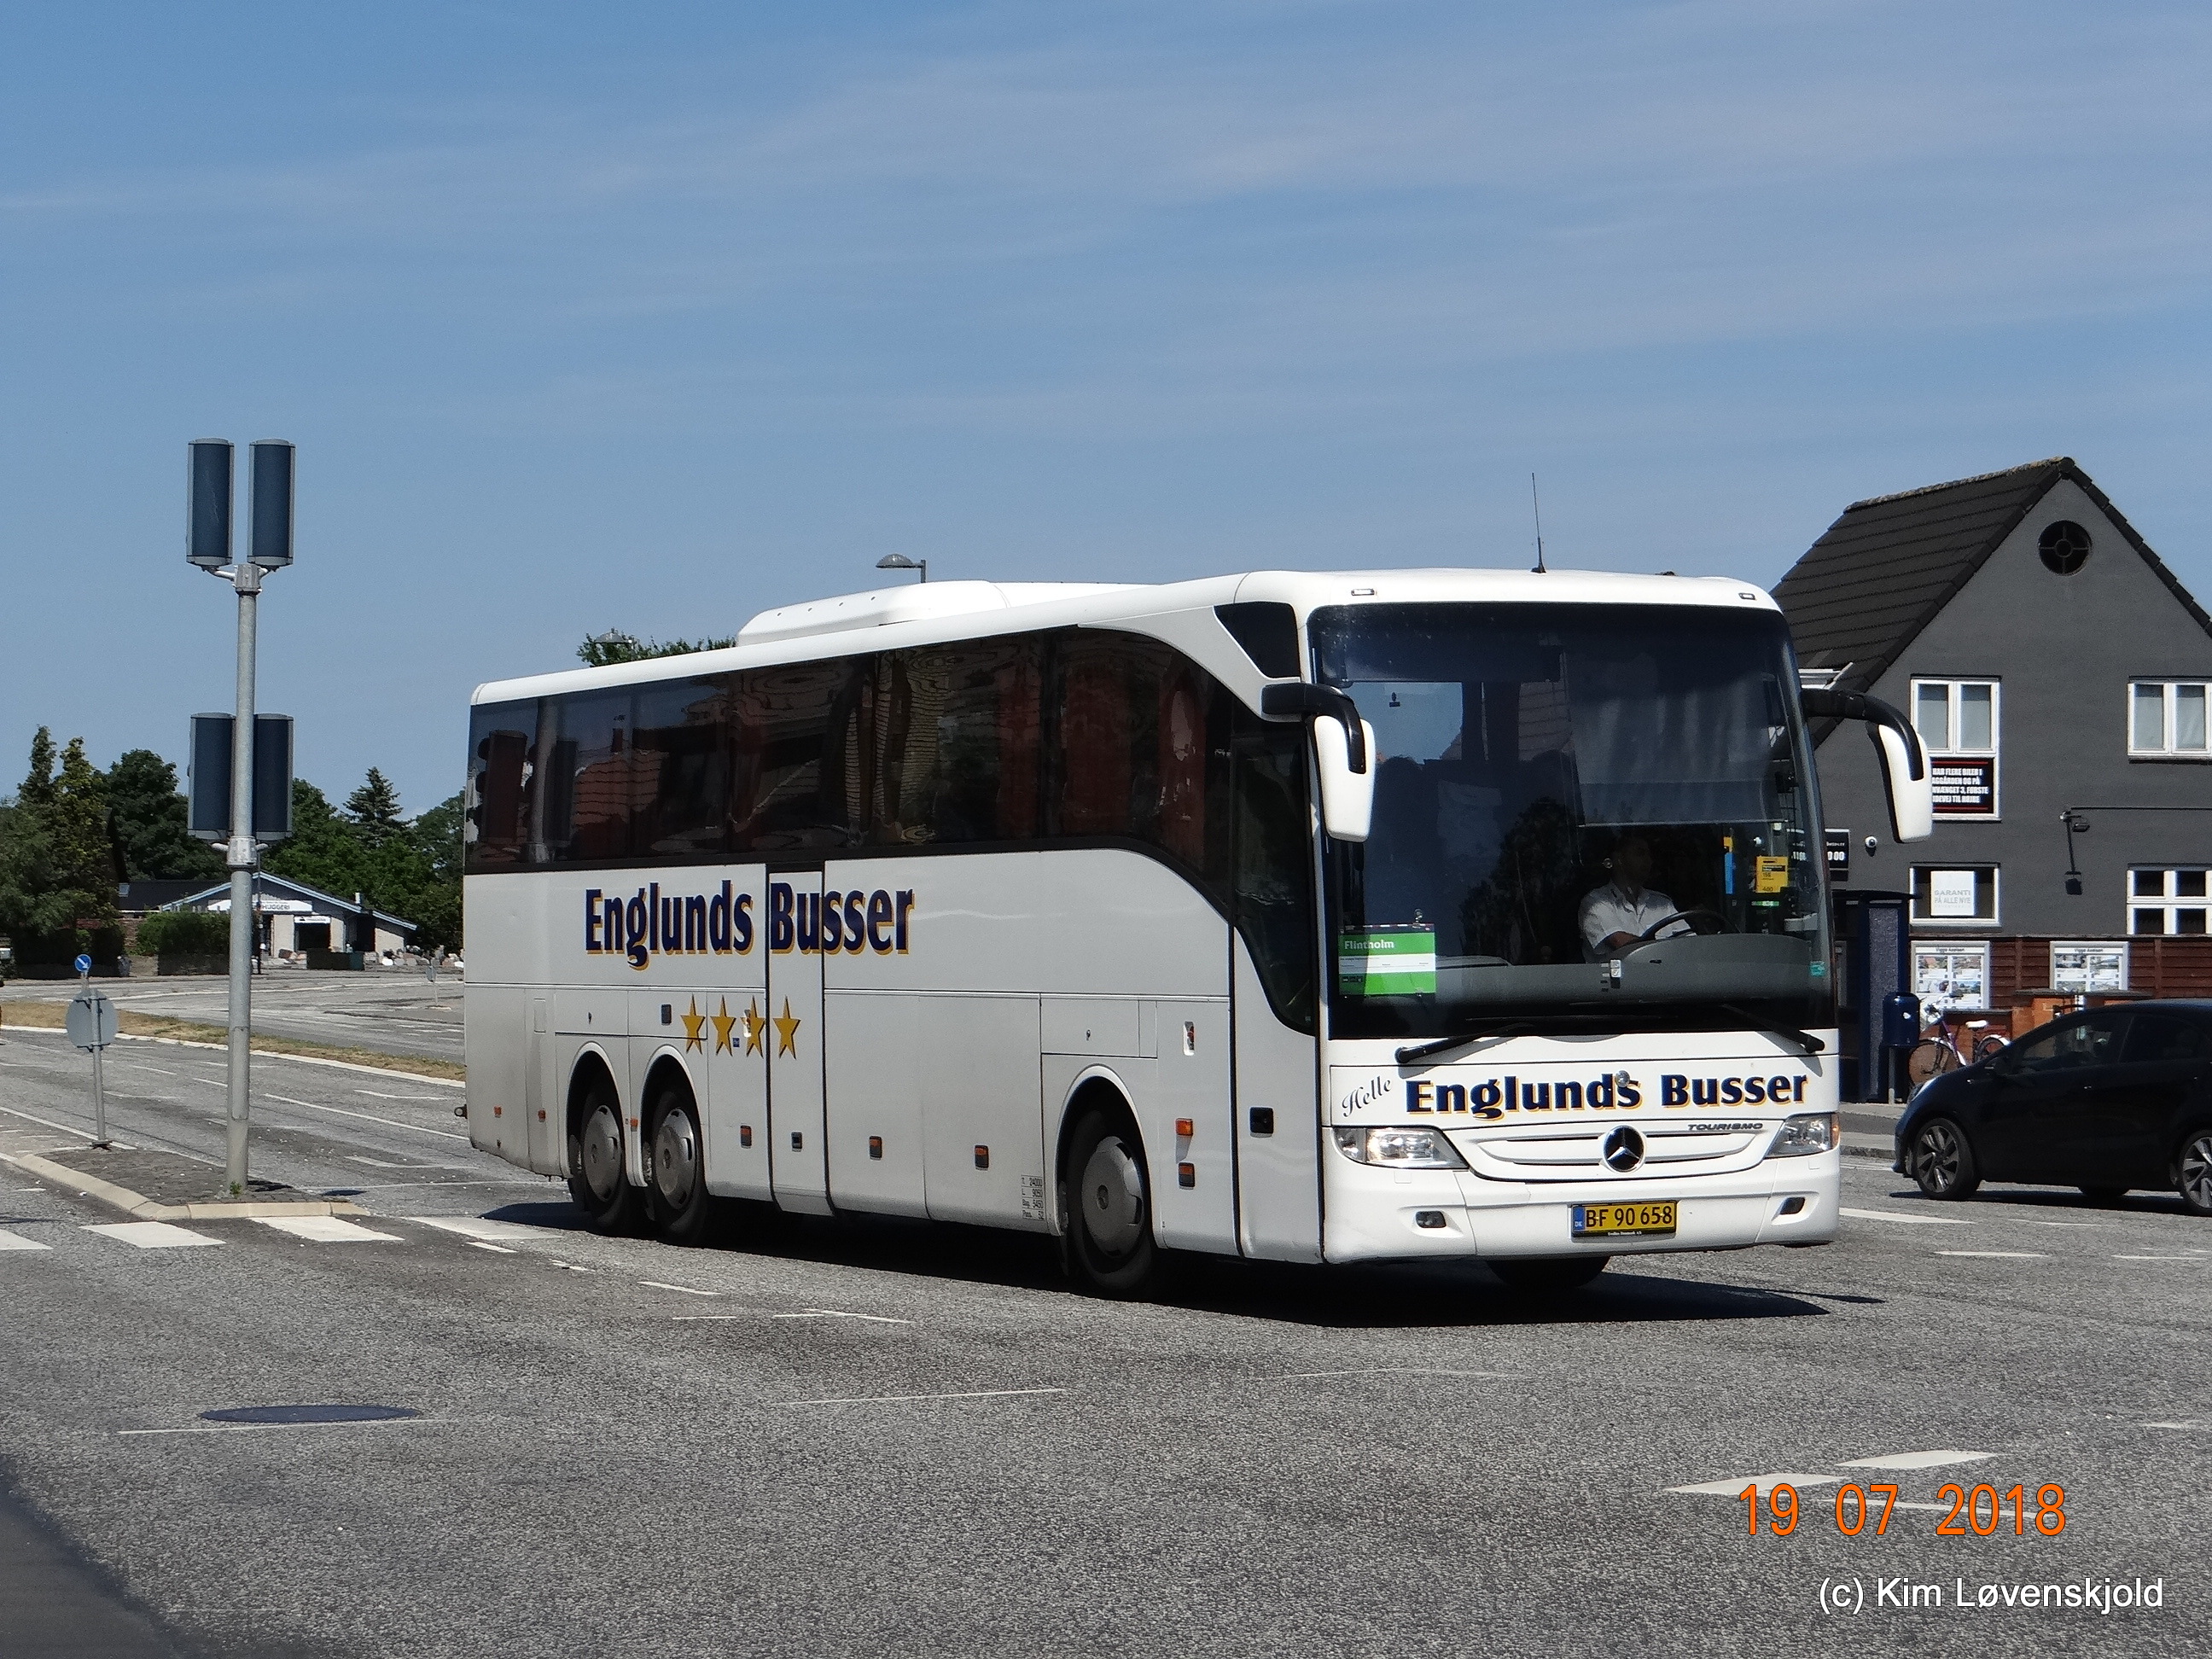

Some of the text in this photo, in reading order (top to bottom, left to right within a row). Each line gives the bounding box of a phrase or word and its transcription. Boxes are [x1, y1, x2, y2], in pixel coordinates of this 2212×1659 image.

[585, 879, 915, 971] Englunds Busser
[1344, 940, 1394, 950] Flintholm
[1342, 1072, 1808, 1120] Helle Englunds Busser
[1687, 1122, 1764, 1131] TOURISMO
[1586, 1209, 1609, 1227] BF
[1615, 1208, 1635, 1226] 90
[1640, 1206, 1673, 1225] 658
